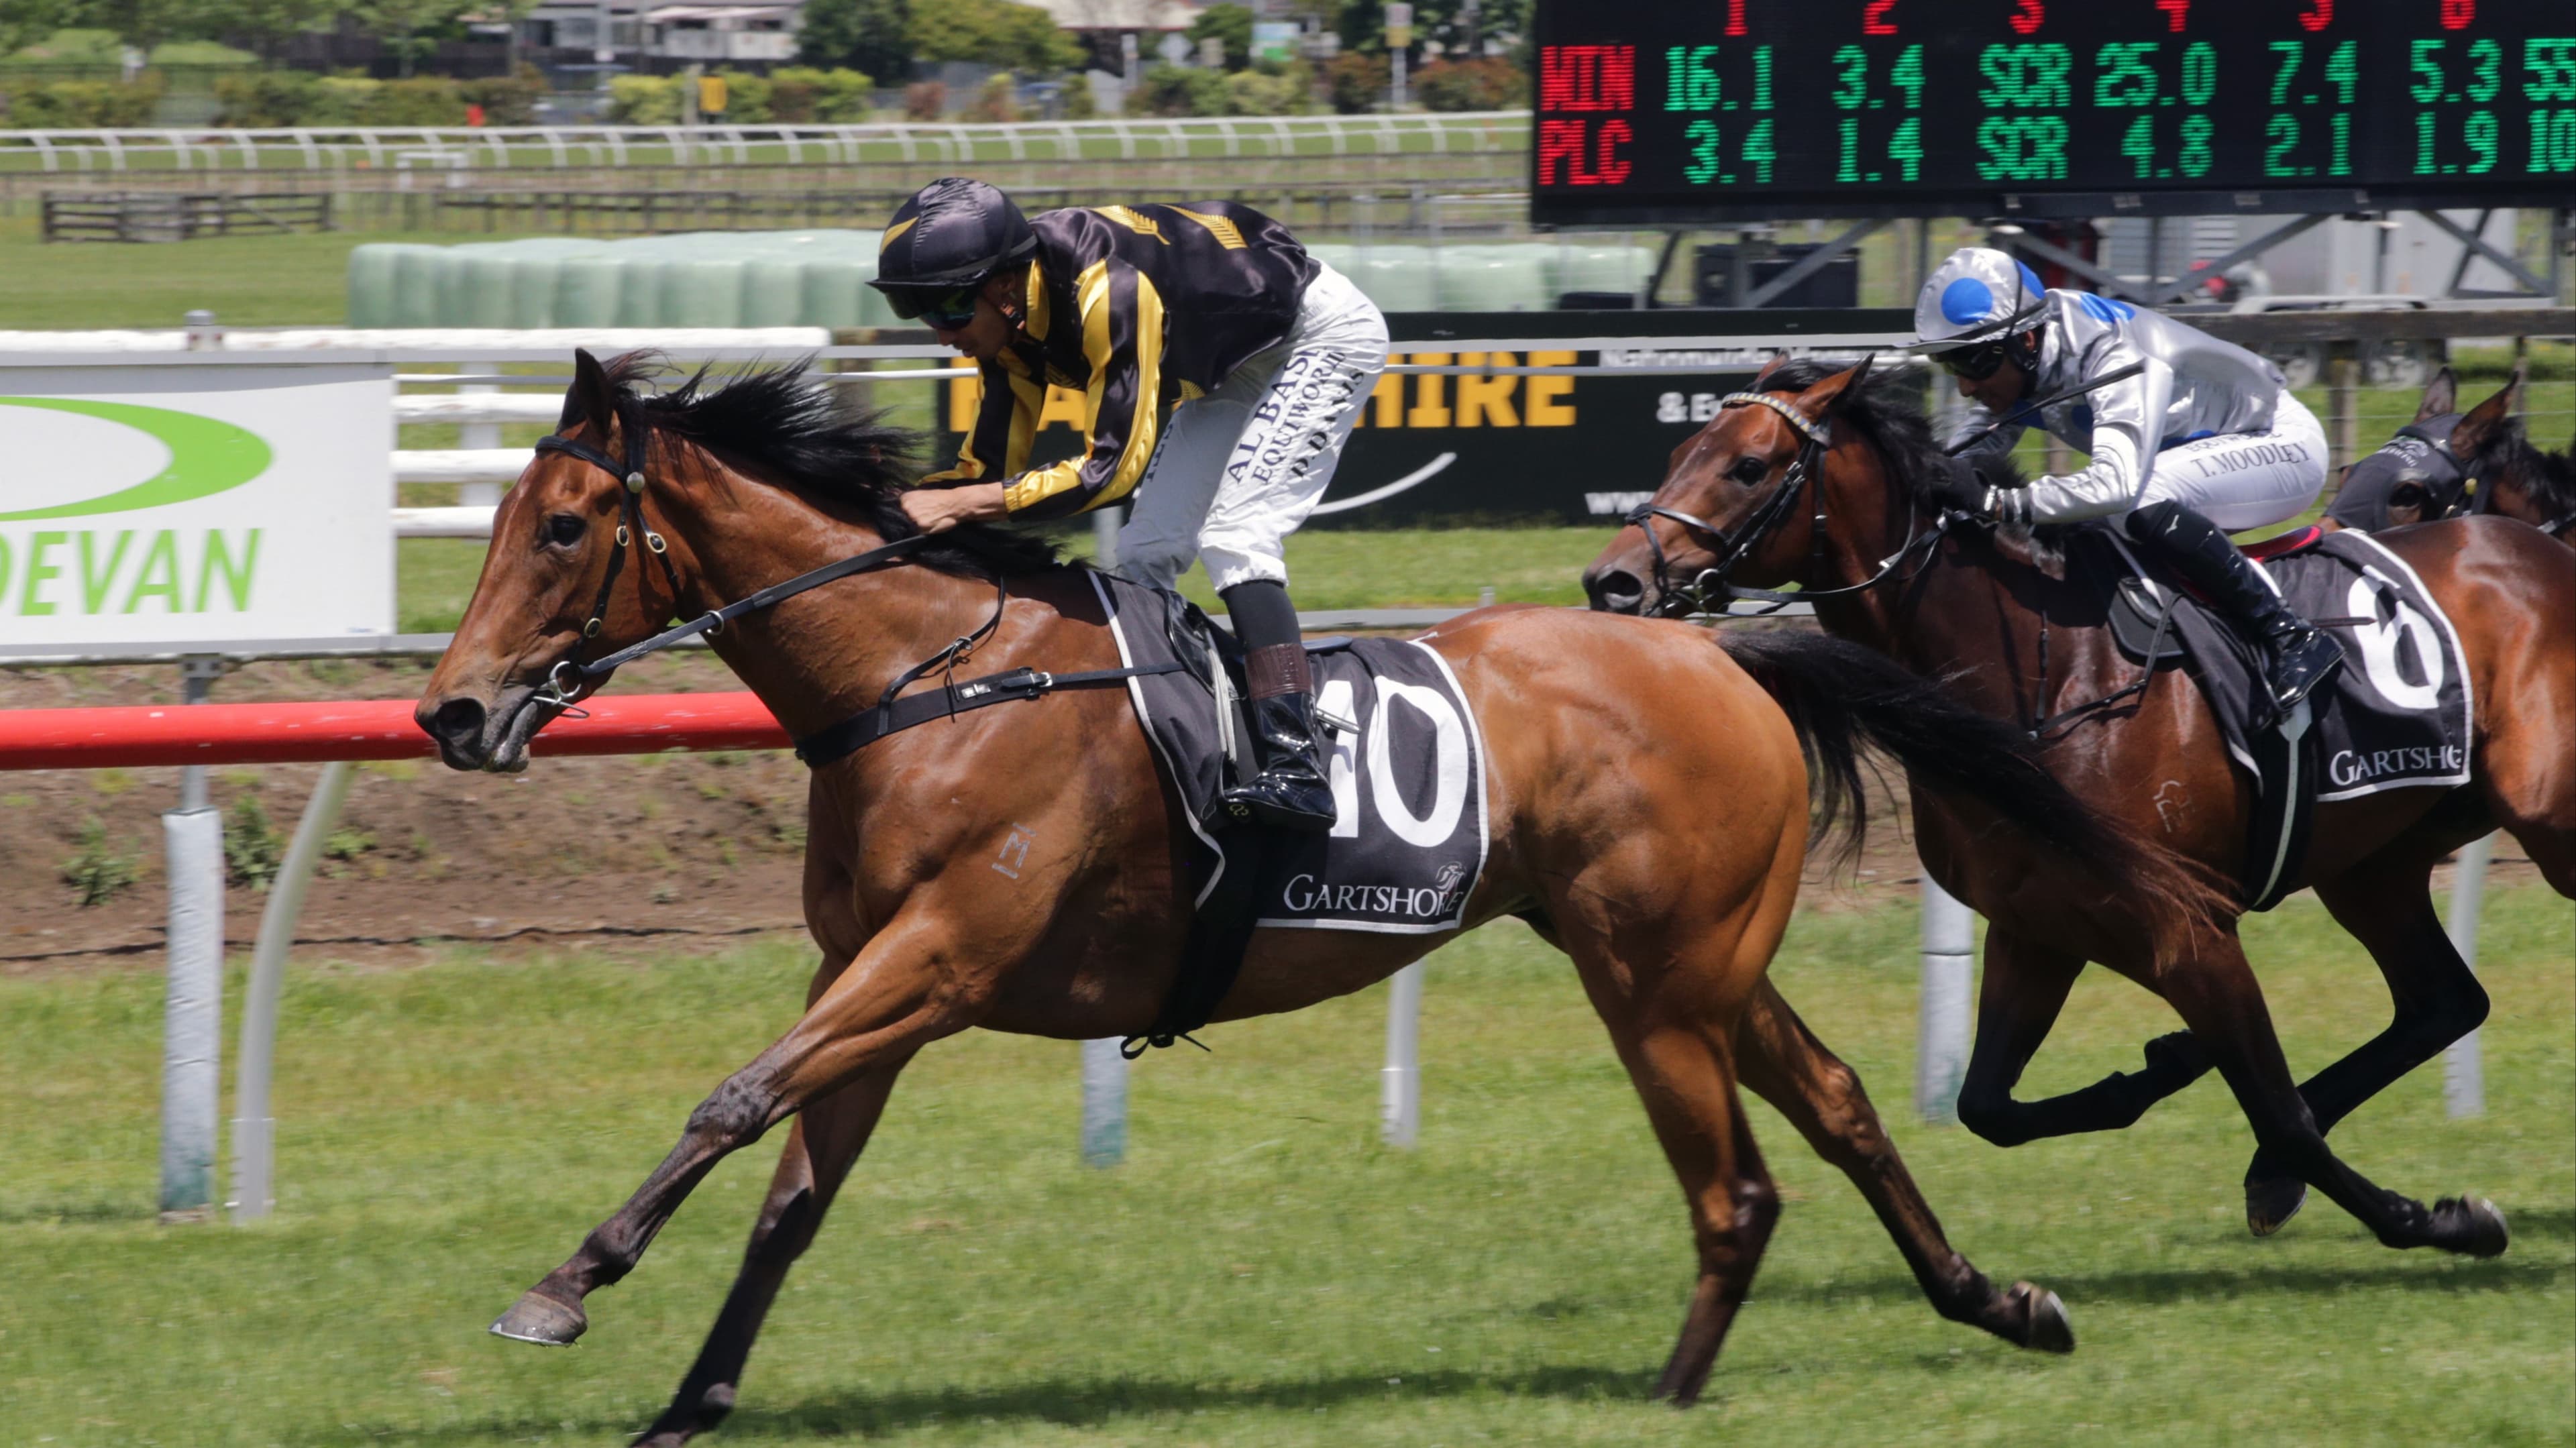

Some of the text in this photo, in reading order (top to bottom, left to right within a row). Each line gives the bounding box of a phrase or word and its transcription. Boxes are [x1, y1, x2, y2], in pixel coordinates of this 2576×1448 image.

[1541, 45, 1635, 111] WIN
[1664, 45, 1774, 111] 16.1
[1832, 44, 1925, 109] 3.4
[1978, 43, 2072, 107] SCR
[2094, 42, 2216, 107] 25.0
[2269, 40, 2359, 104] 7.4
[2410, 39, 2502, 103] 5.3
[1538, 119, 1633, 185] PLC
[1684, 119, 1776, 184] 3.4
[1836, 117, 1924, 182] 1.4
[1976, 115, 2069, 180] SCR
[2122, 114, 2213, 178] 4.8
[2265, 113, 2351, 176] 2.1
[2414, 110, 2498, 174] 1.9
[1228, 433, 1264, 484] AL
[1316, 675, 1469, 847] 10
